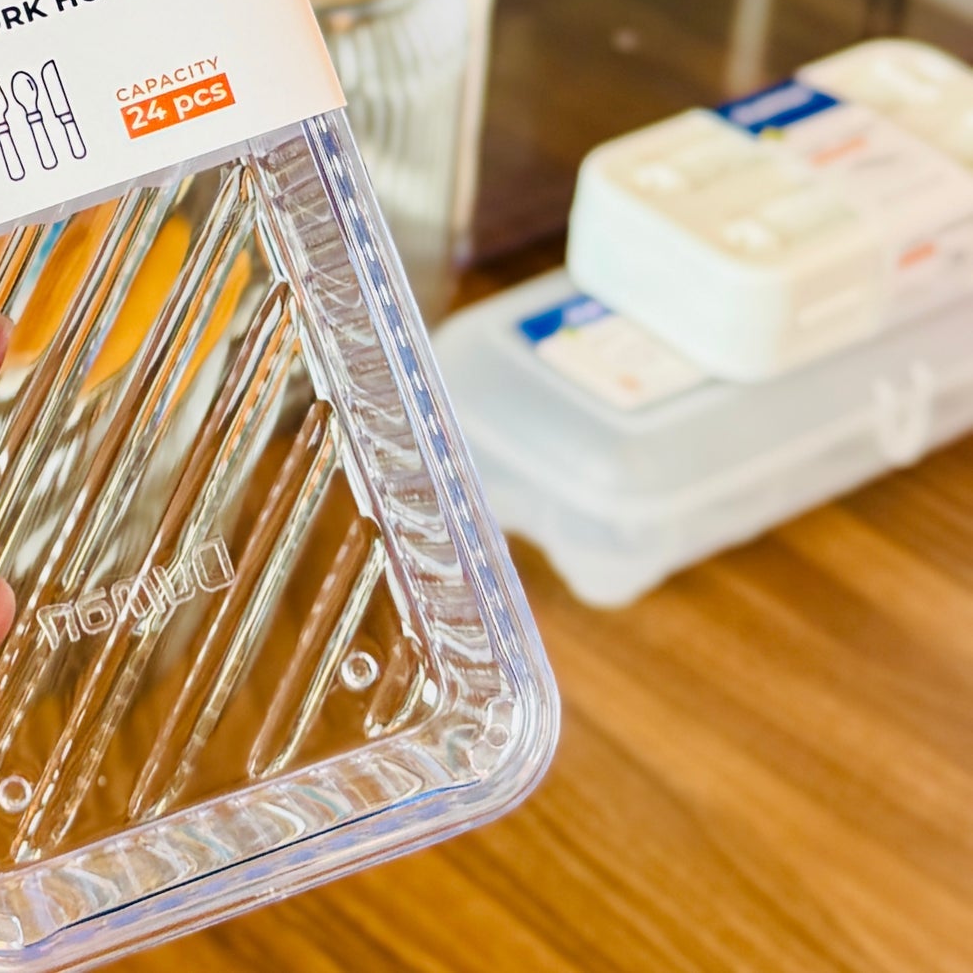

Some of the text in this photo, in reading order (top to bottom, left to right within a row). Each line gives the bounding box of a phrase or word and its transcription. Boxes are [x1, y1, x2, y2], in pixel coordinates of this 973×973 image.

[115, 55, 219, 102] CAPACITY
[126, 82, 228, 131] 24 pcs
